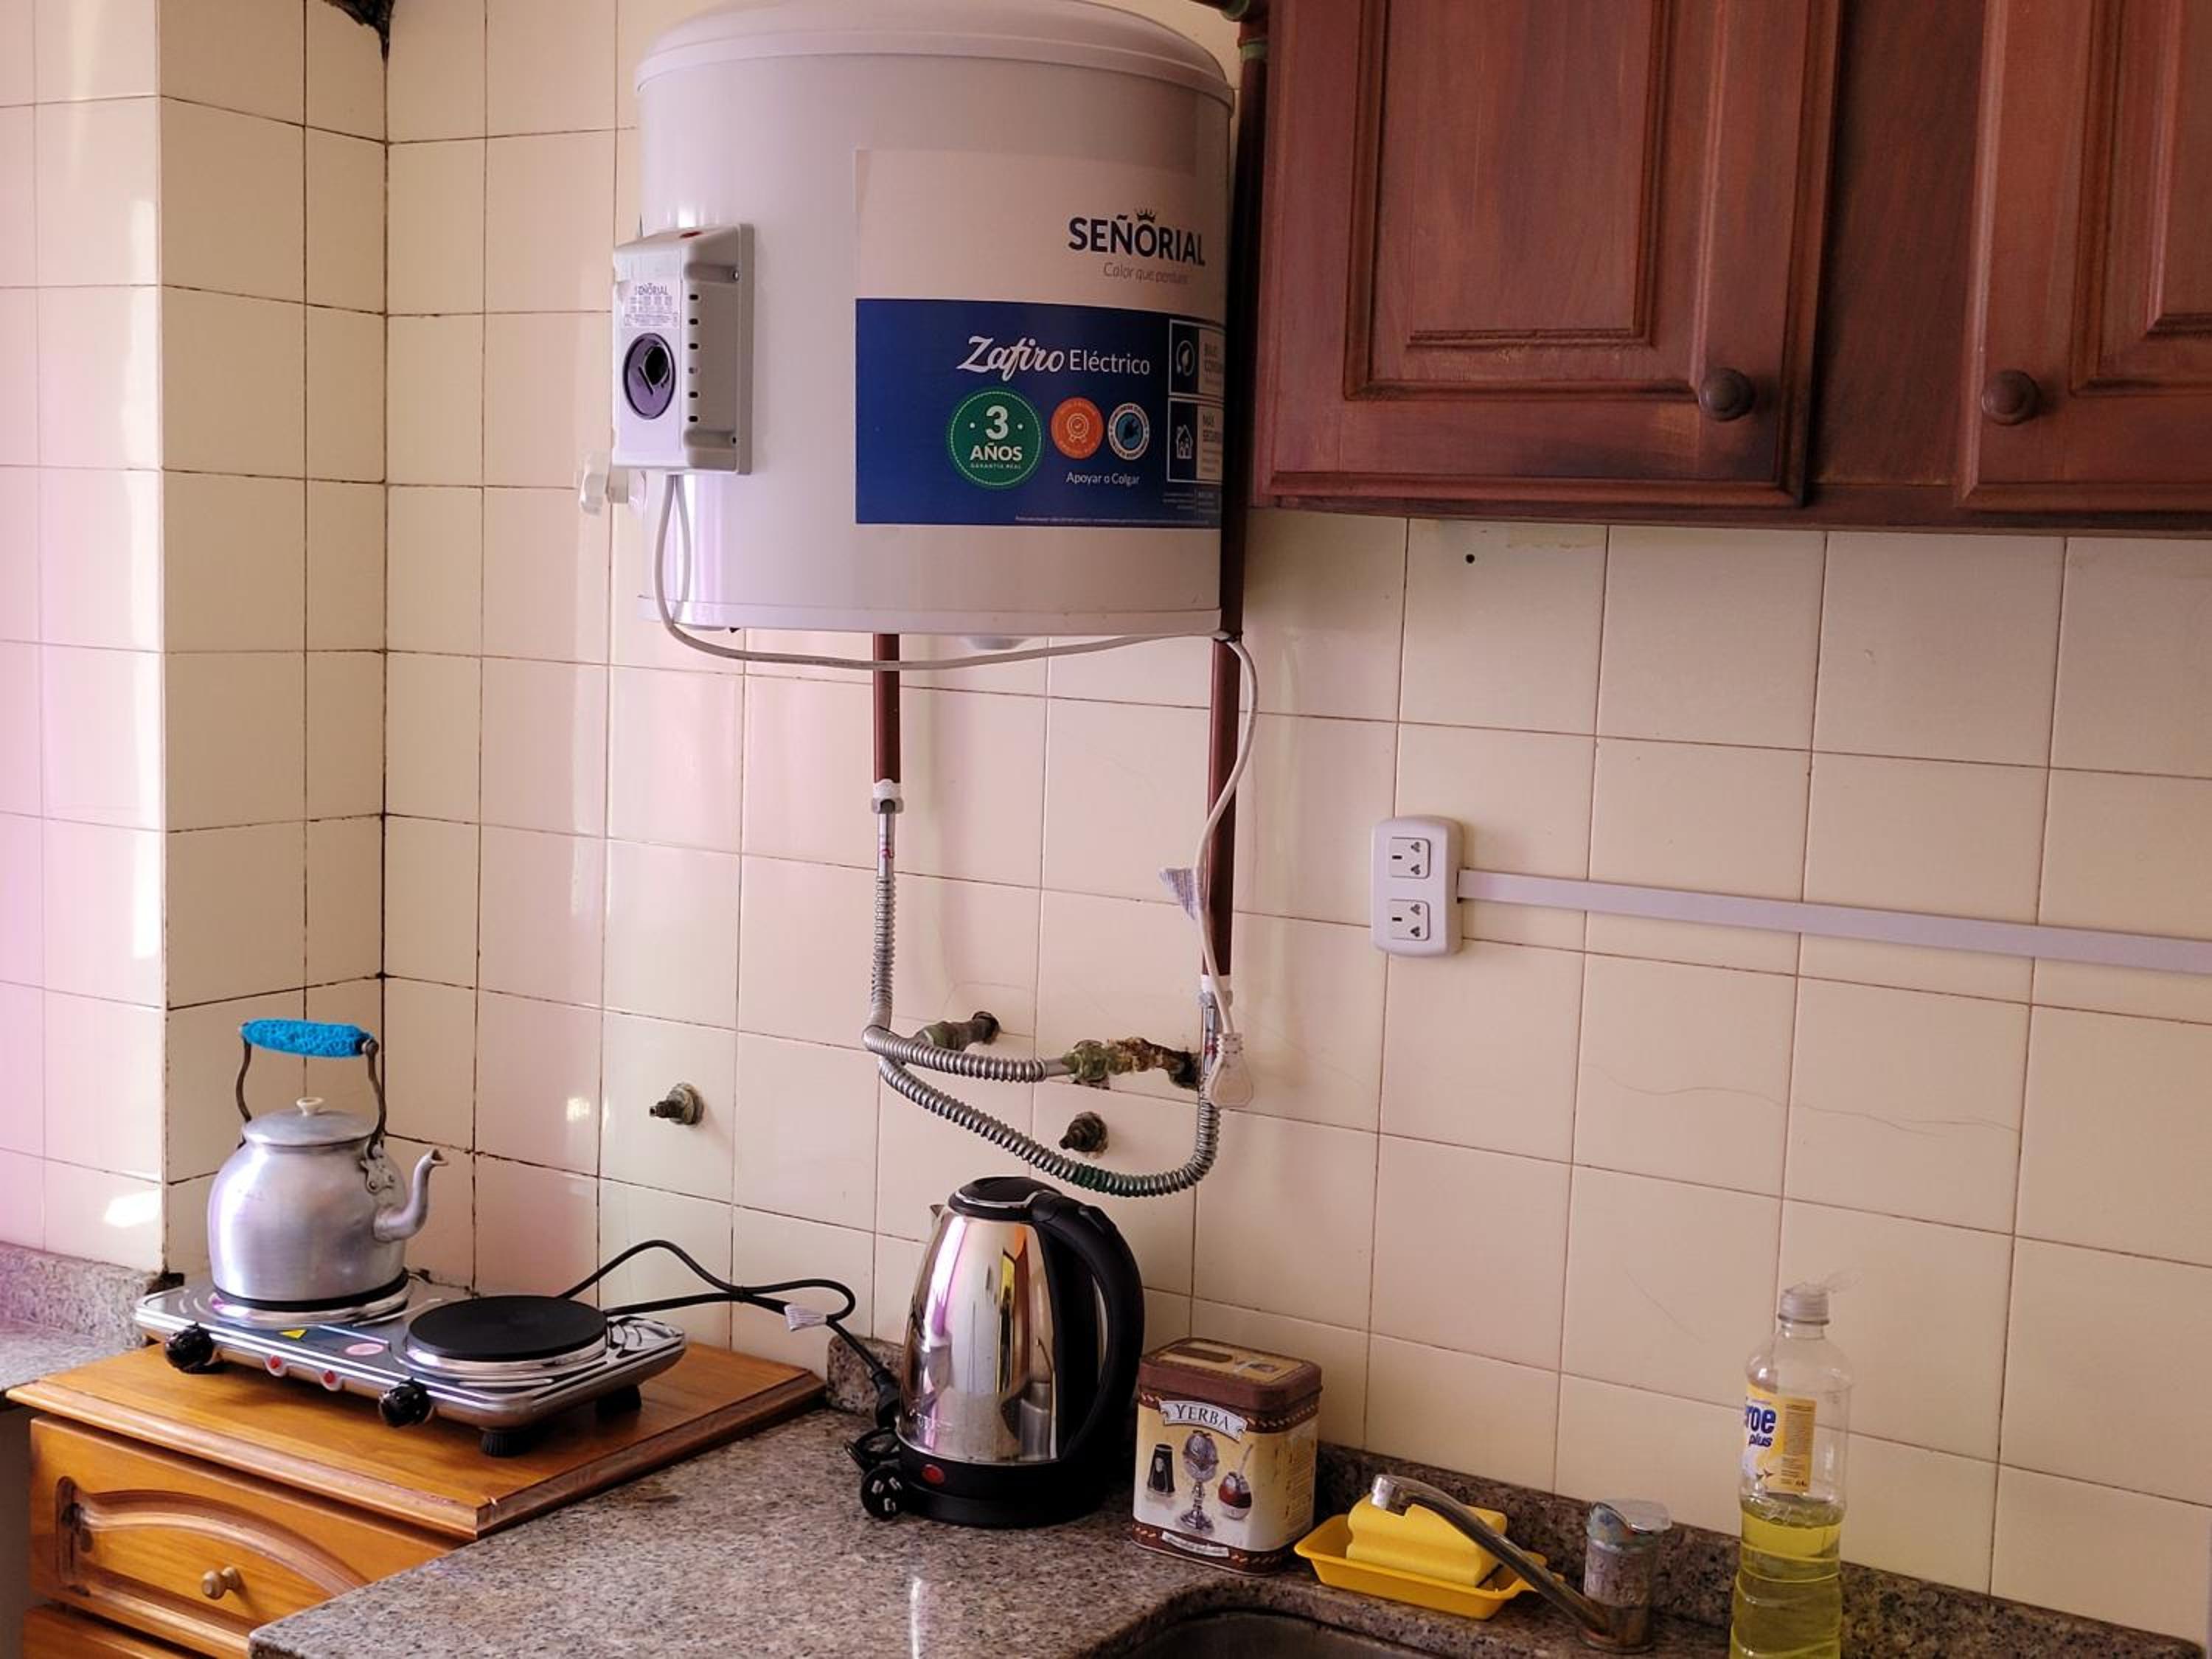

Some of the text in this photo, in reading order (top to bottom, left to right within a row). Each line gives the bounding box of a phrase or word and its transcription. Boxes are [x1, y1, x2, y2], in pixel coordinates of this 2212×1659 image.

[1068, 214, 1206, 267] SEÑORIAL
[956, 335, 1150, 381] Zafiro Eléctrico
[985, 405, 1009, 440] 3
[970, 442, 1023, 461] AÑOS
[1065, 471, 1102, 484] Apoyar
[1110, 473, 1141, 486] Colgar
[1175, 1404, 1228, 1430] YERBA
[1749, 1433, 1773, 1447] plus
